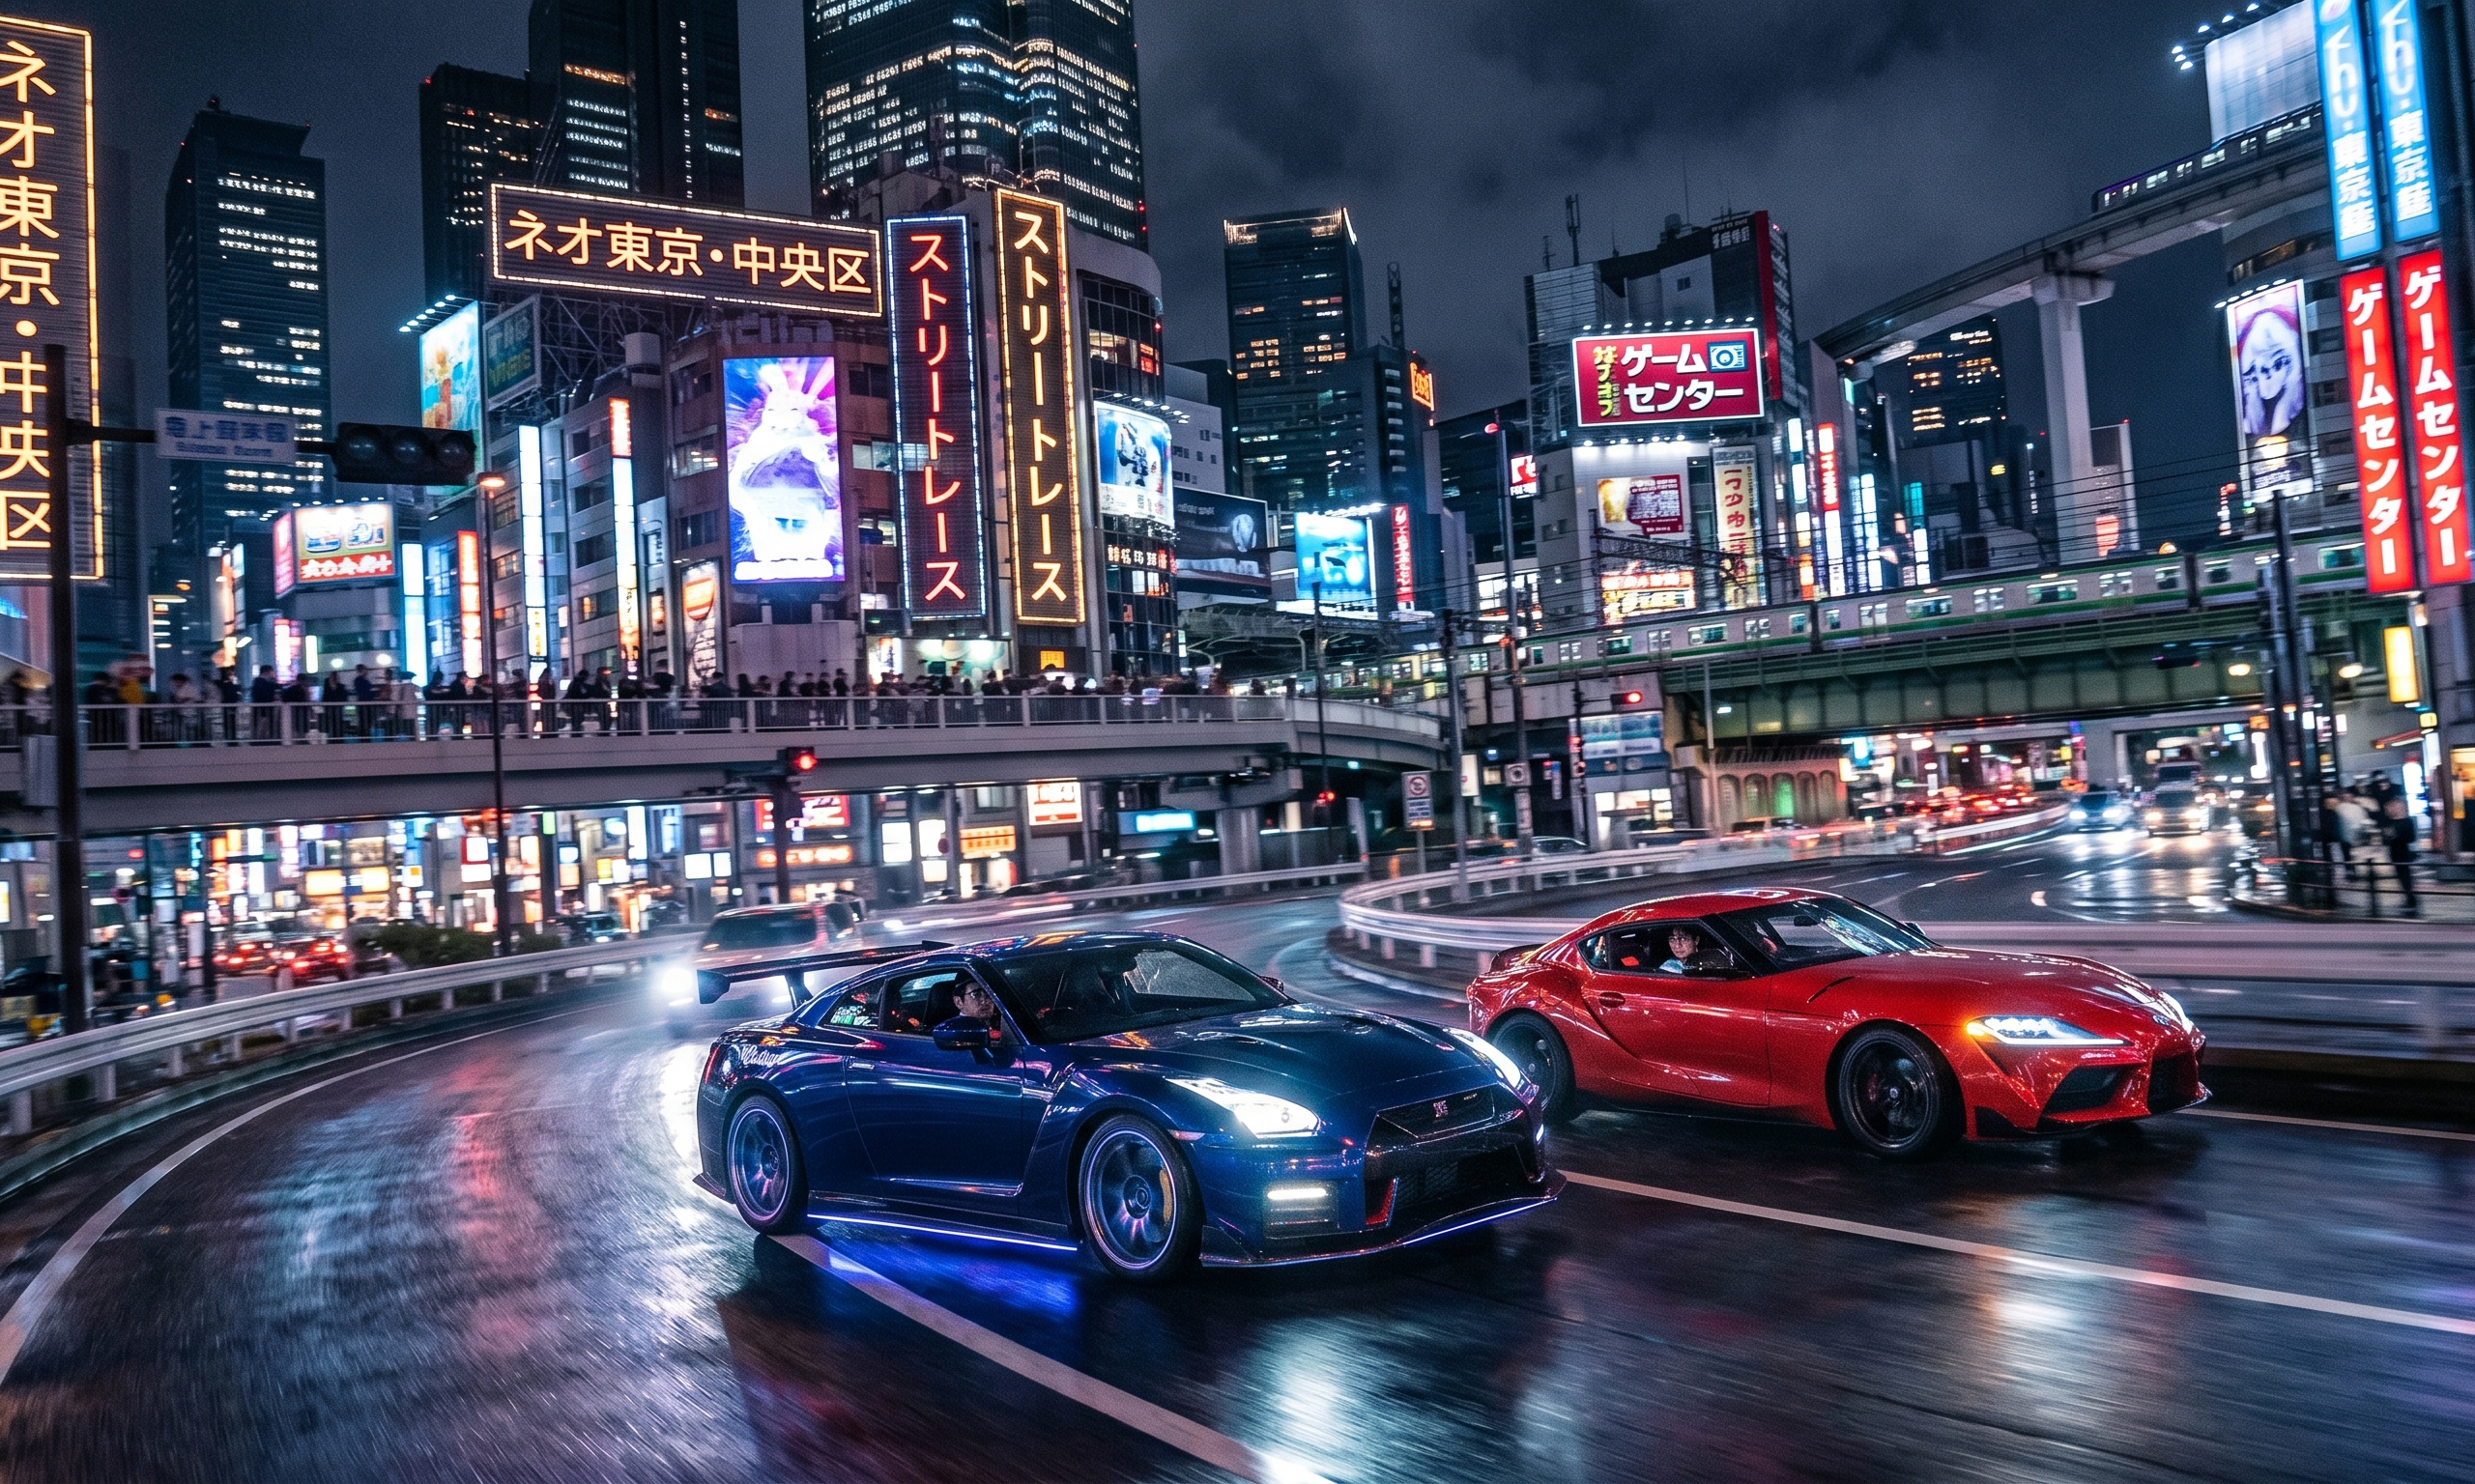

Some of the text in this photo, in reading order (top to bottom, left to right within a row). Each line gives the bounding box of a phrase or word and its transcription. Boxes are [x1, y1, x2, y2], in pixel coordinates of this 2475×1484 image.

[0, 40, 59, 551] ネオ東京・中央区
[504, 209, 874, 294] ネオ東京・中央区
[1620, 343, 1708, 378] ゲーム
[1624, 379, 1744, 414] センター
[908, 233, 966, 603] ストリートレース
[1013, 210, 1068, 603] ストリートレース
[2346, 282, 2403, 575] ゲームセンター
[2404, 265, 2461, 568] ゲームセンター
